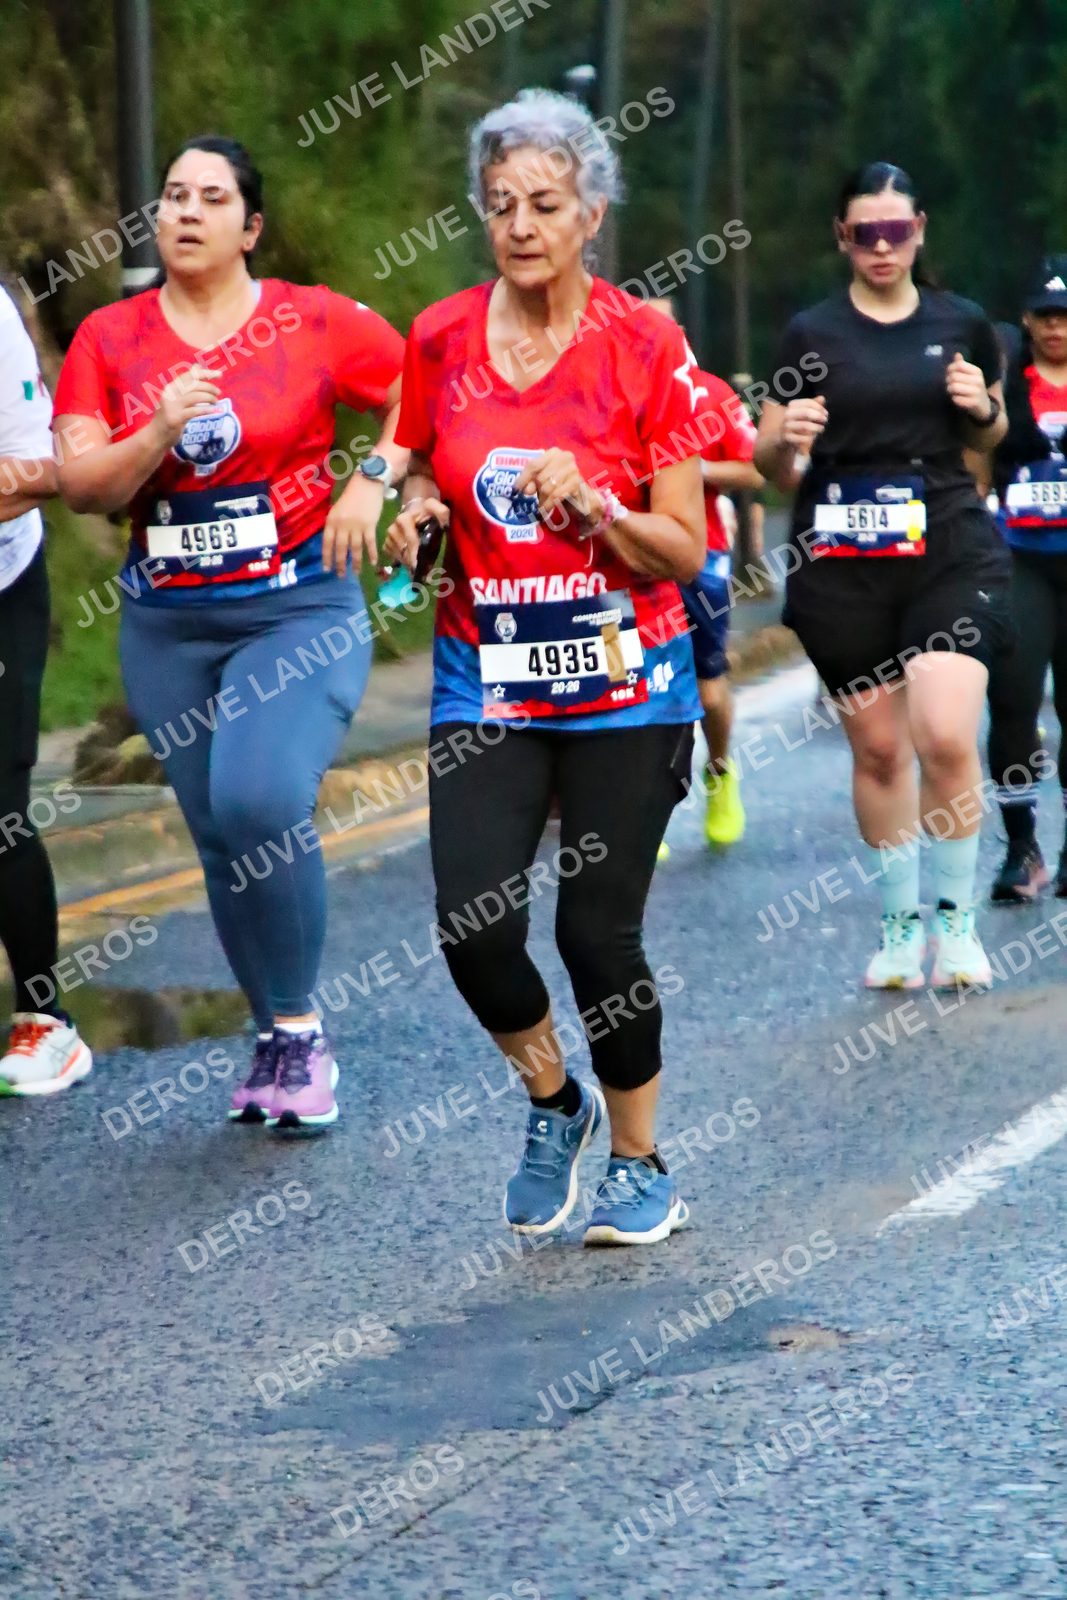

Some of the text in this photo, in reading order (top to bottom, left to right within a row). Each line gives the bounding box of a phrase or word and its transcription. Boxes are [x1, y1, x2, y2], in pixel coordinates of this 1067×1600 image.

[847, 507, 888, 528] 5614
[181, 522, 238, 552] 4963
[469, 572, 607, 605] SANTIAGO
[528, 641, 598, 676] 4935
[610, 687, 635, 701] 10K
